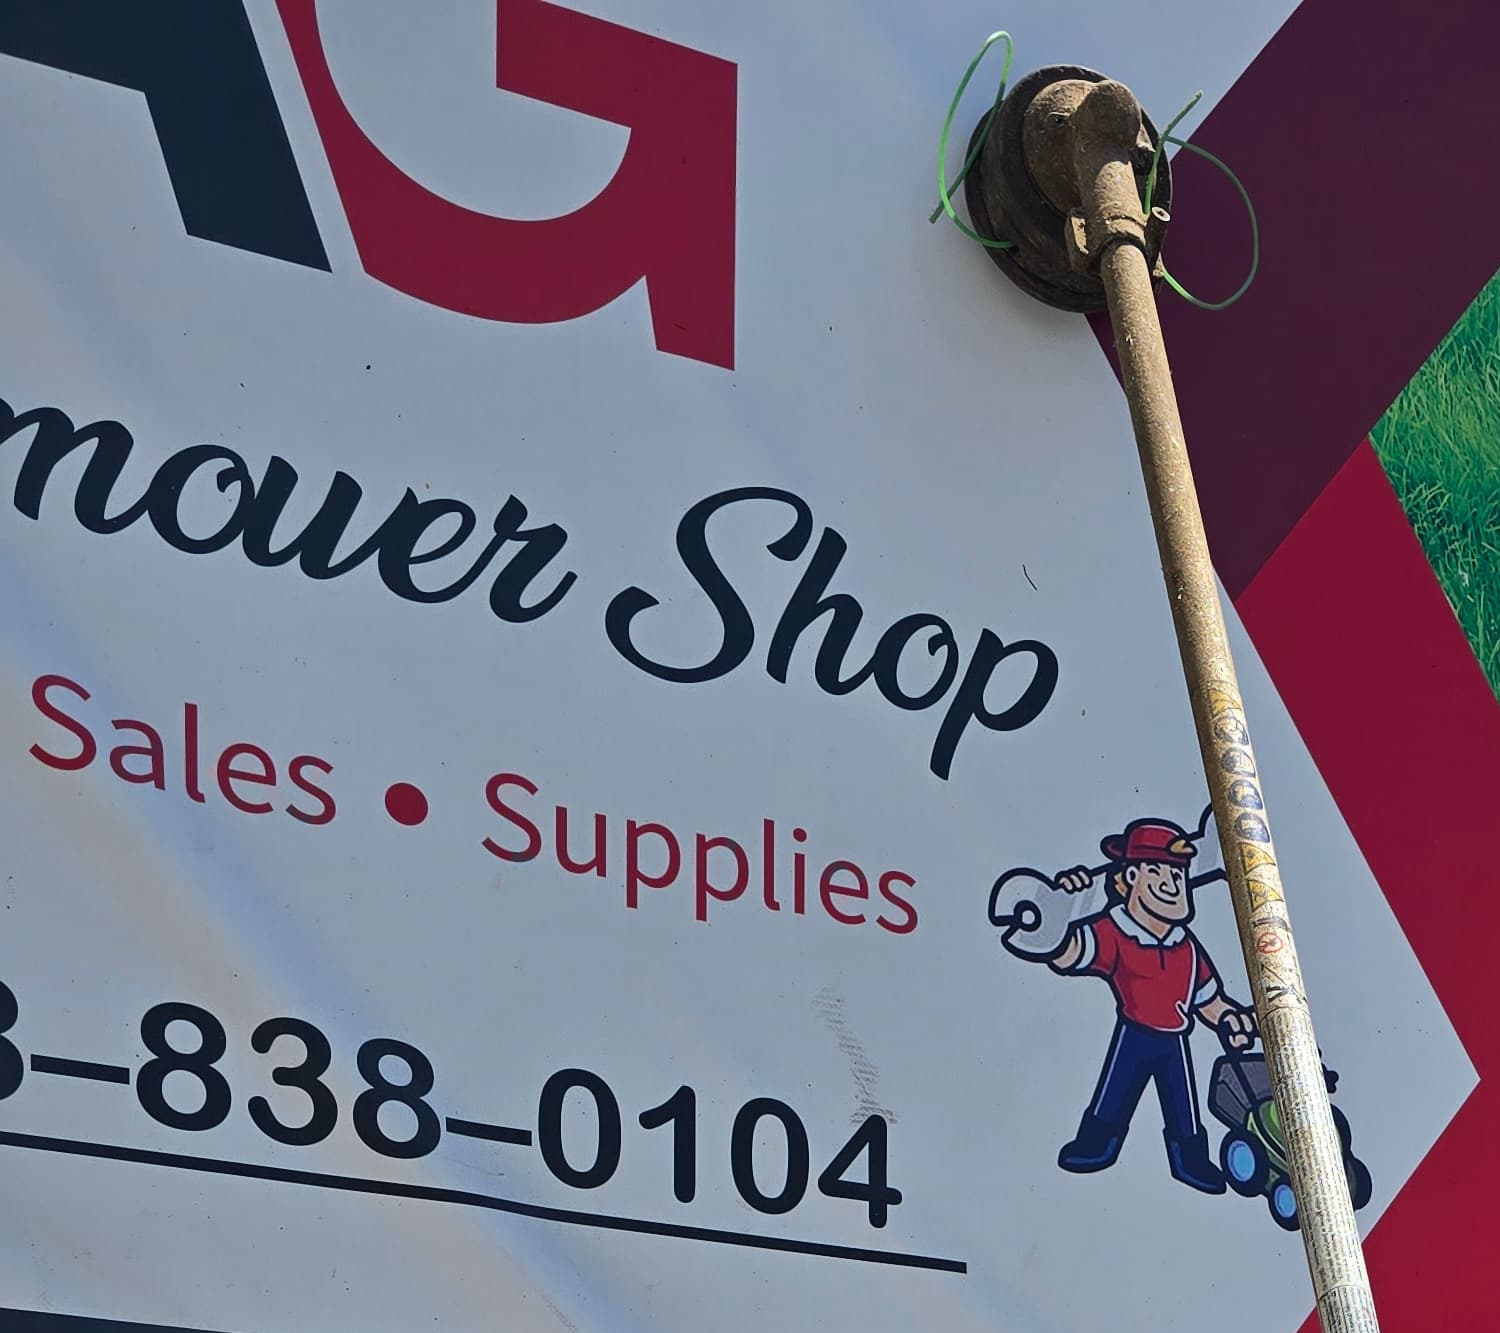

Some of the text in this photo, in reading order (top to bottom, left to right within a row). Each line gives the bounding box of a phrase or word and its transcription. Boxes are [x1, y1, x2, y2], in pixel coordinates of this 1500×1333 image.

[605, 487, 1058, 780] Shop
[30, 675, 918, 934] Sales Supplies
